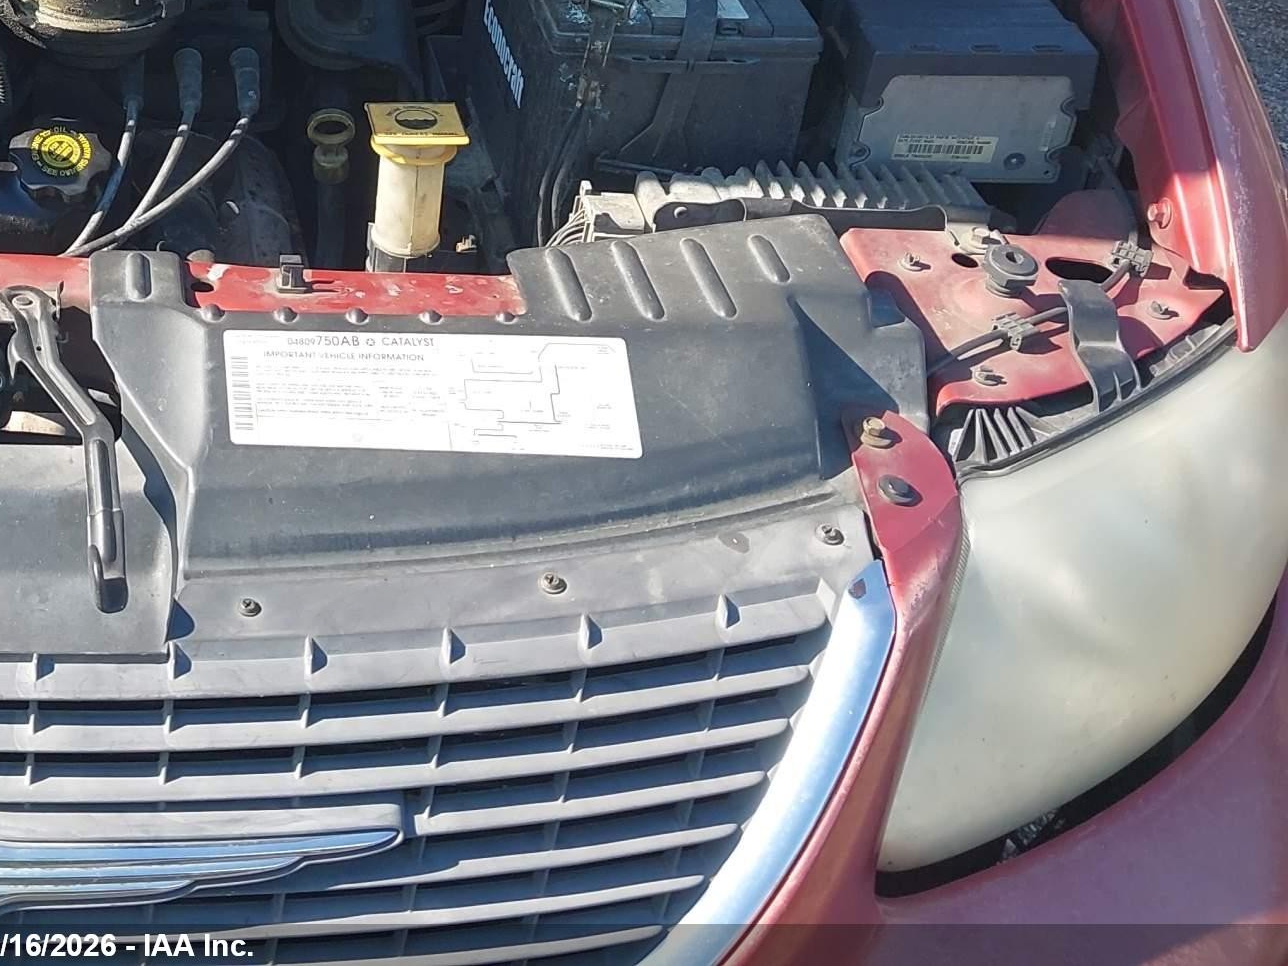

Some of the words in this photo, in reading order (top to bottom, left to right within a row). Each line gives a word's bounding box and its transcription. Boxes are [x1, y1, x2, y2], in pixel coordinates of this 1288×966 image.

[381, 337, 434, 347] CATALYST
[263, 350, 314, 359] IMPORTANT
[318, 352, 355, 360] VEHICLE
[358, 352, 425, 362] INFORMATION
